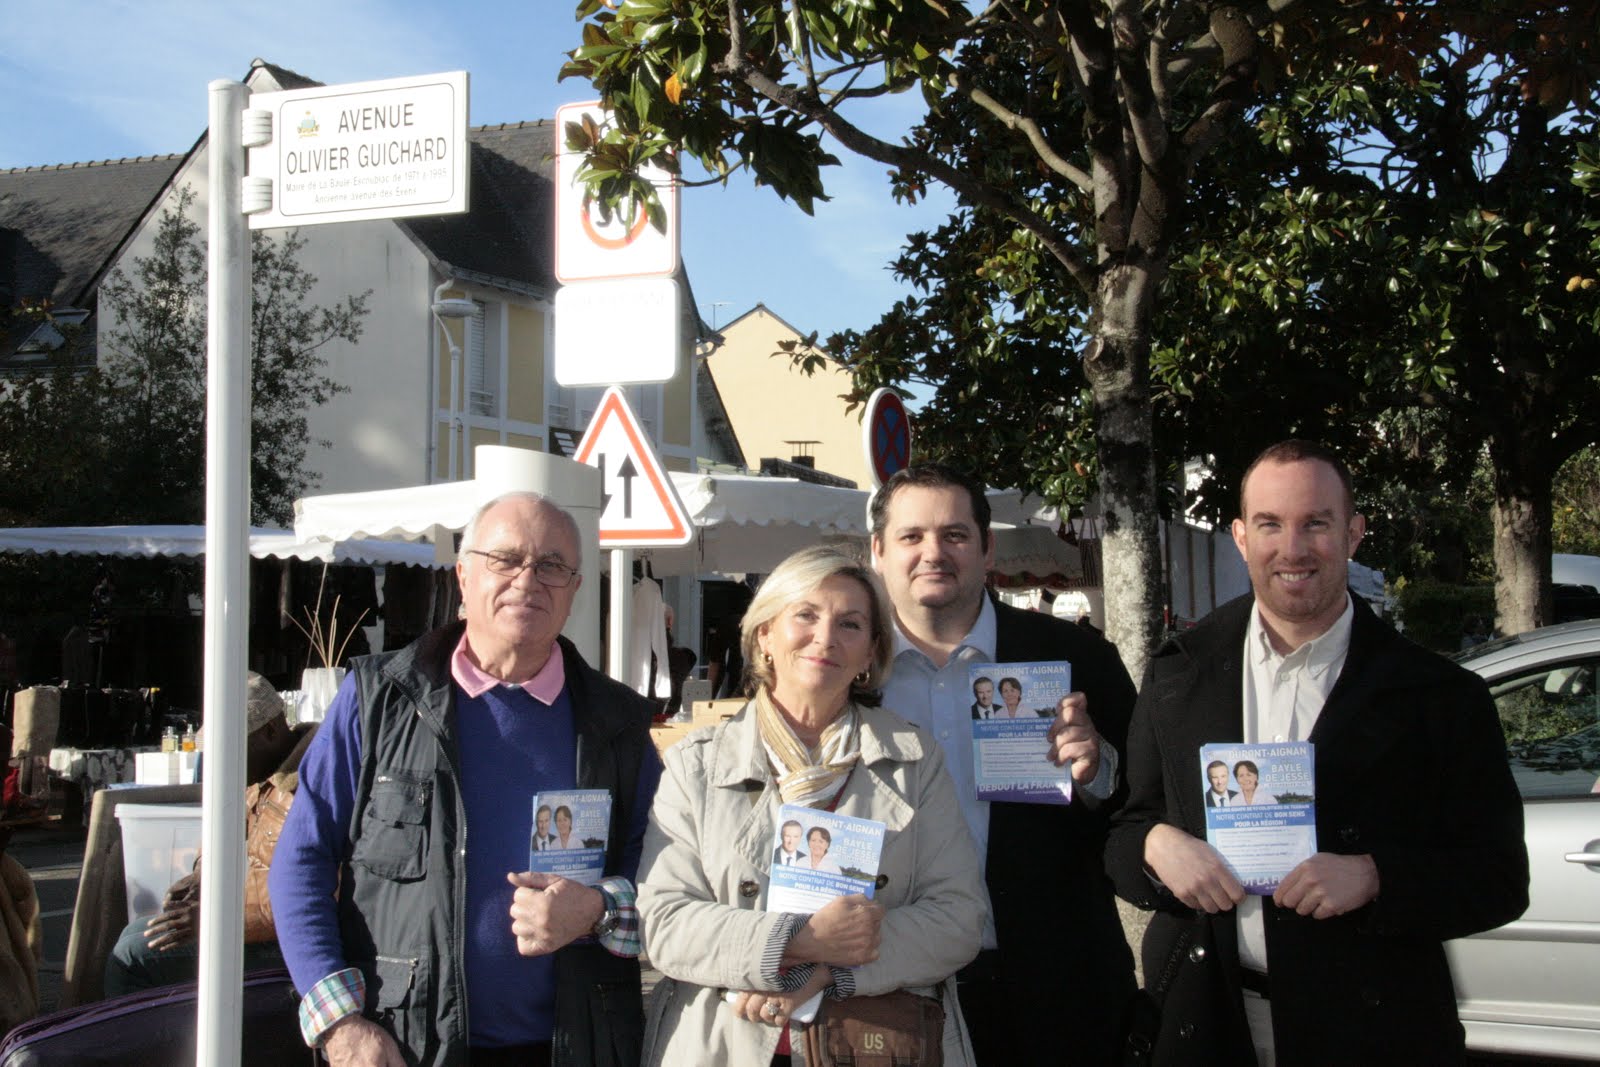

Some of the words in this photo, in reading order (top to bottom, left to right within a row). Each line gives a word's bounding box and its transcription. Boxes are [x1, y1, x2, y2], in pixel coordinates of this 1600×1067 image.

[338, 103, 414, 133] AVENUE
[286, 146, 350, 175] OLIVIER
[358, 137, 447, 168] GUICHARD
[286, 182, 305, 192] Maire
[307, 180, 317, 190] de
[392, 173, 402, 182] de
[314, 193, 348, 204] Ancienne
[351, 190, 377, 200] avenue
[379, 188, 393, 198] des
[1033, 681, 1061, 689] BAYLE
[1229, 747, 1307, 759] DUPONT-AIGNAN
[1271, 764, 1302, 772] BAYLE
[1265, 774, 1278, 782] DE
[979, 783, 1015, 792] DEBOUT
[1017, 782, 1030, 790] LA
[843, 837, 873, 851] BAYLE
[864, 1032, 884, 1050] US
